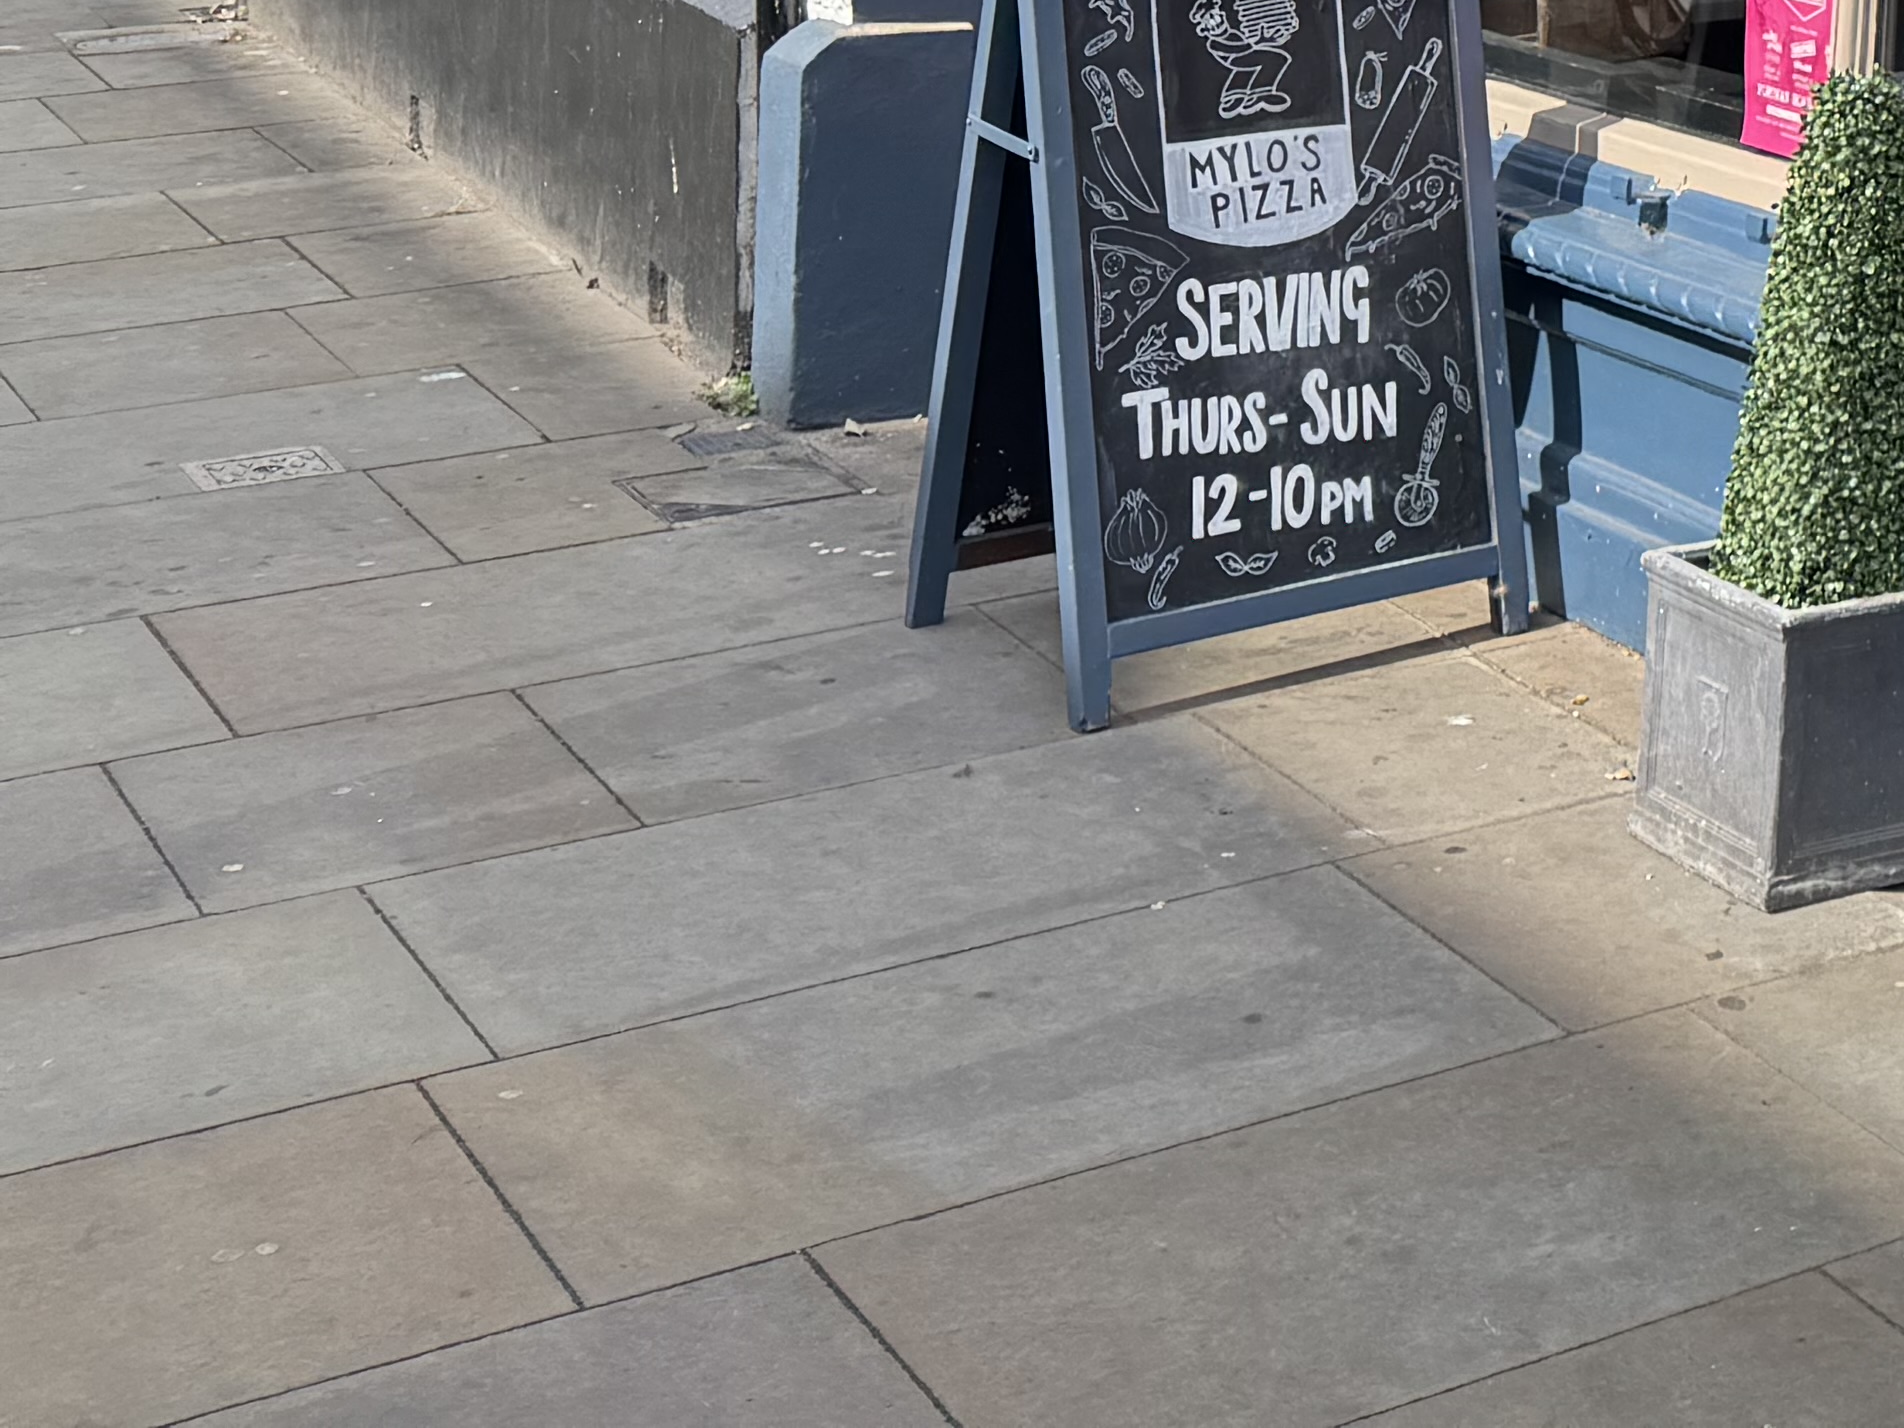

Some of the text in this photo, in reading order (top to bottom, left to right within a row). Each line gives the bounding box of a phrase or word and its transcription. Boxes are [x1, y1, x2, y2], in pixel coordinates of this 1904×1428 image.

[1187, 132, 1323, 192] MYLO'S
[1208, 176, 1330, 230] PIZZA
[1174, 264, 1371, 363] SERVING
